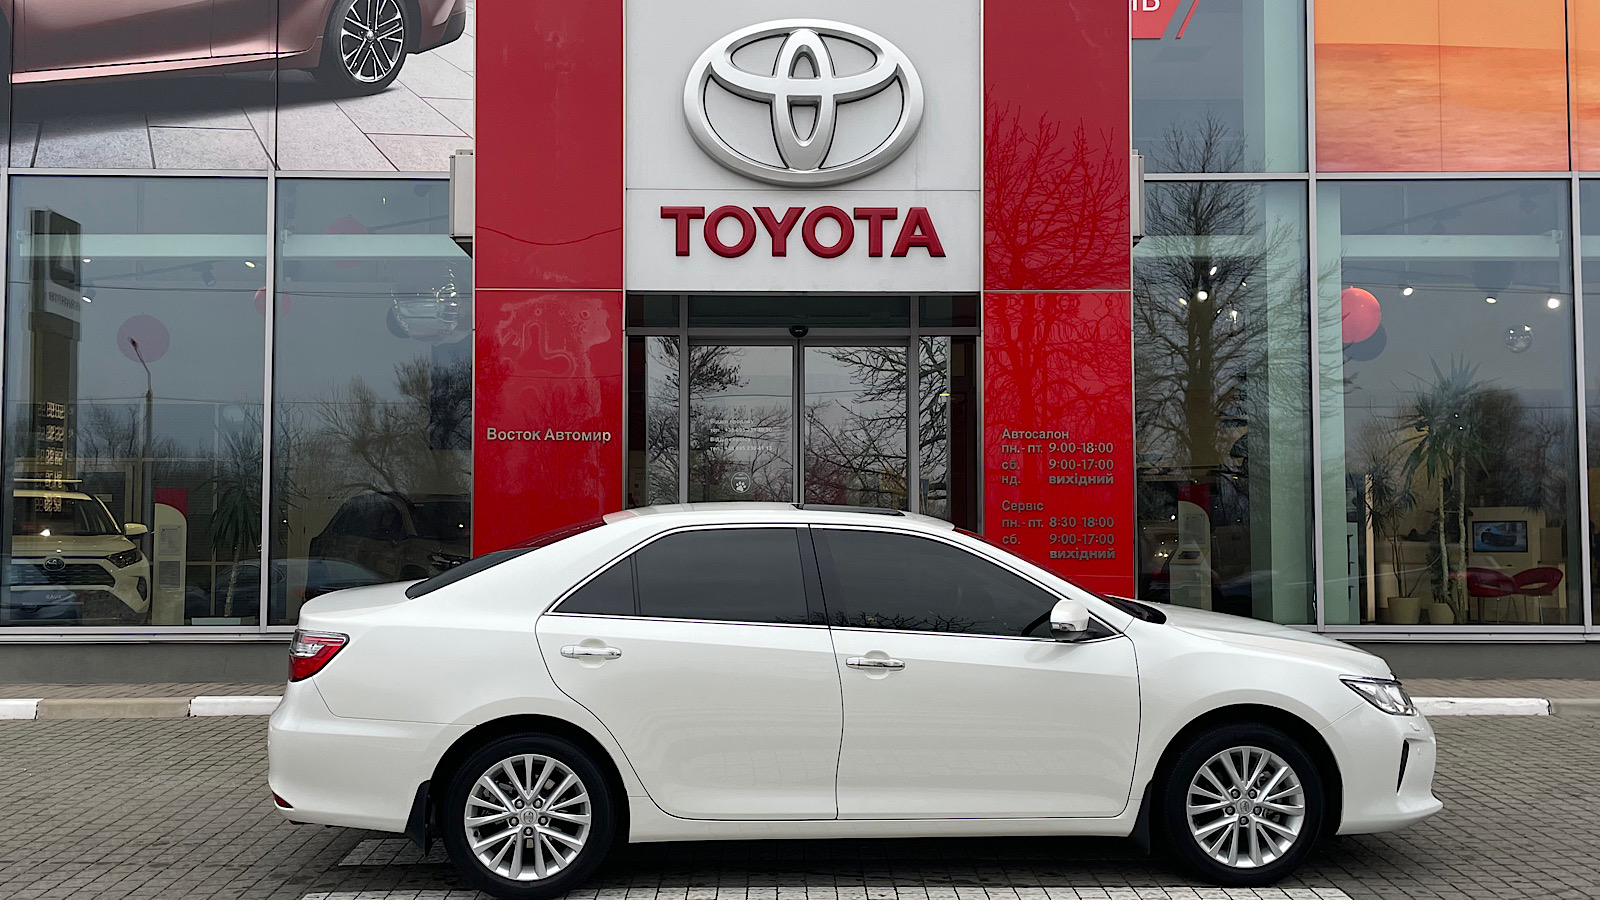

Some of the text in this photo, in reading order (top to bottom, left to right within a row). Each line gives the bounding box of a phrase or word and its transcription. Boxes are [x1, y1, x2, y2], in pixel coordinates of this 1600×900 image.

[660, 205, 946, 258] TOYOTA
[487, 427, 612, 444] Восток Автомир
[1001, 429, 1069, 440] Автосалон
[1027, 444, 1043, 453] пт.
[1001, 459, 1114, 470] сб. 9:00-17:00
[1001, 473, 1115, 486] нд. вихідний
[1001, 499, 1044, 513] Сервіс
[1028, 519, 1044, 528] пт.
[1002, 533, 1115, 545] сб. 9:00-17:00
[1049, 547, 1116, 560] вихідний
